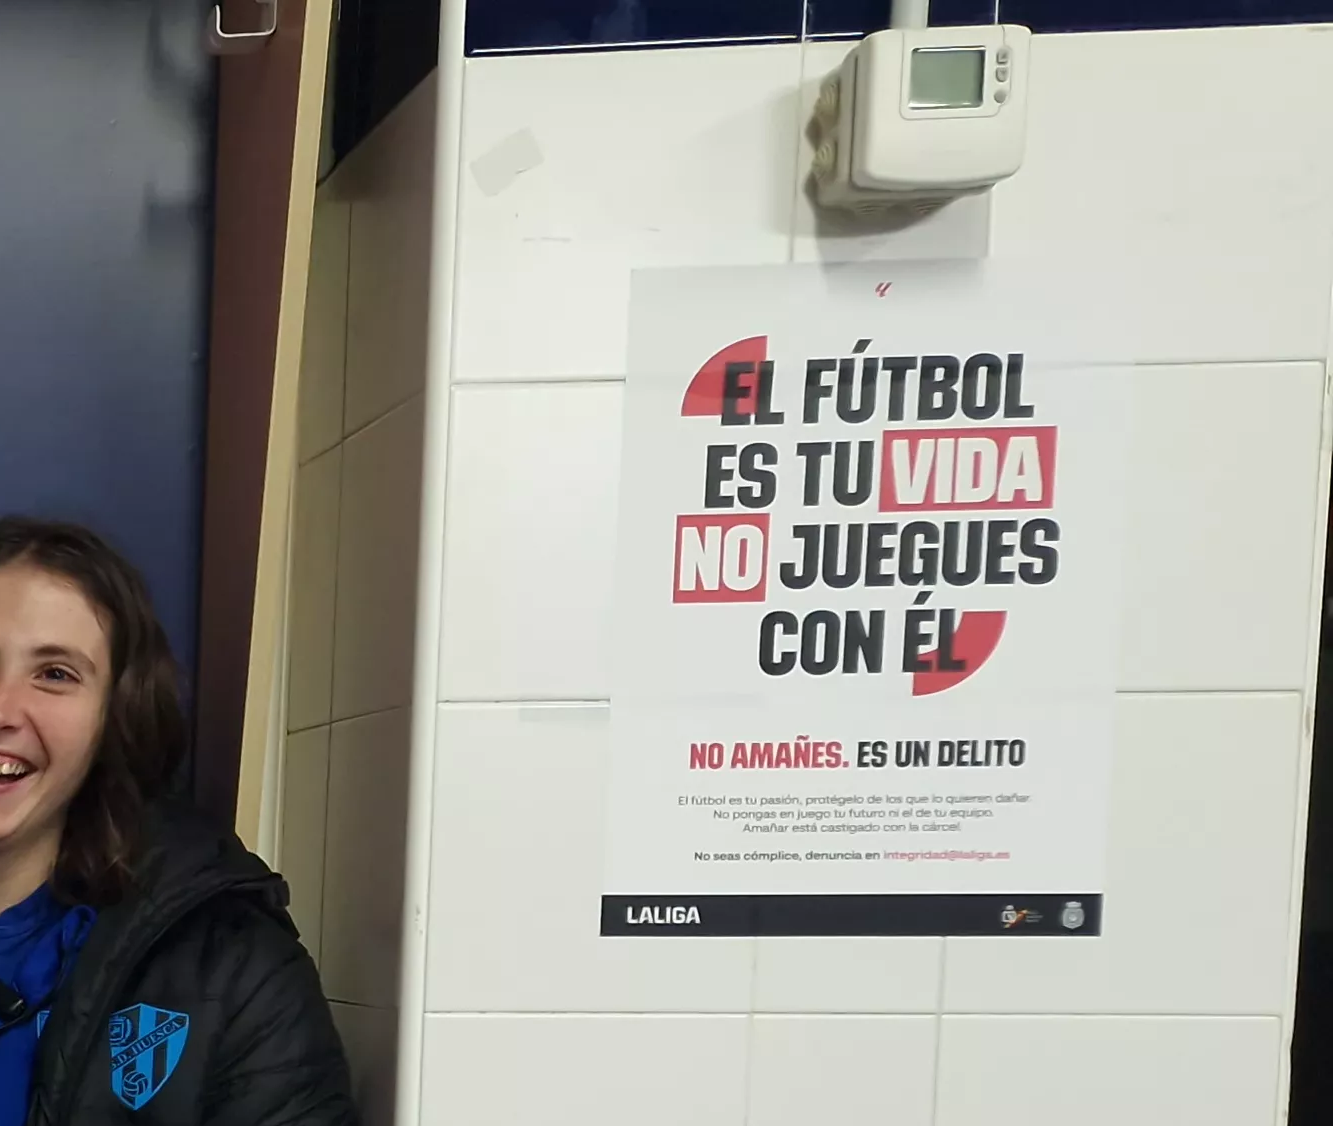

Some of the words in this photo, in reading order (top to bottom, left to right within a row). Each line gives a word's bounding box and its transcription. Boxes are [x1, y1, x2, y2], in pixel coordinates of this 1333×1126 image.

[720, 359, 785, 426] EL
[802, 338, 1035, 424] FÚTBOL
[704, 442, 779, 509] ES
[796, 440, 875, 506] TU
[890, 436, 1044, 505] VIDA
[678, 523, 765, 592] NO
[779, 517, 1062, 590] JUEGUES
[758, 609, 886, 676] CON
[901, 590, 968, 674] ÉL
[689, 742, 724, 769] NO
[730, 735, 849, 769] AMAÑES.
[856, 740, 888, 768] ES
[894, 740, 931, 768] UN
[936, 739, 1027, 767] DELITO
[677, 795, 689, 806] El
[691, 794, 726, 806] fútbol
[728, 797, 742, 806] es
[745, 796, 757, 806] tu
[759, 794, 802, 807] pasión,
[805, 794, 864, 807] protégelo
[867, 795, 882, 805] de
[886, 794, 902, 804] los
[905, 795, 929, 806] que
[713, 810, 730, 820] No
[733, 811, 777, 822] pongas
[779, 811, 793, 820] en
[795, 809, 831, 821] juego
[833, 809, 846, 819] tu
[848, 808, 886, 819] futuro
[901, 808, 914, 818] el
[915, 808, 932, 818] de
[934, 808, 947, 818] tu
[743, 822, 789, 833] Amañar
[792, 822, 818, 833] está
[820, 821, 881, 834] castigado
[883, 823, 906, 832] con
[908, 822, 919, 832] la
[694, 851, 711, 861] No
[713, 852, 741, 861] seas
[743, 850, 802, 862] cómplice,
[805, 850, 862, 861] denuncia
[864, 851, 881, 860] en
[626, 906, 701, 924] LALIGA
